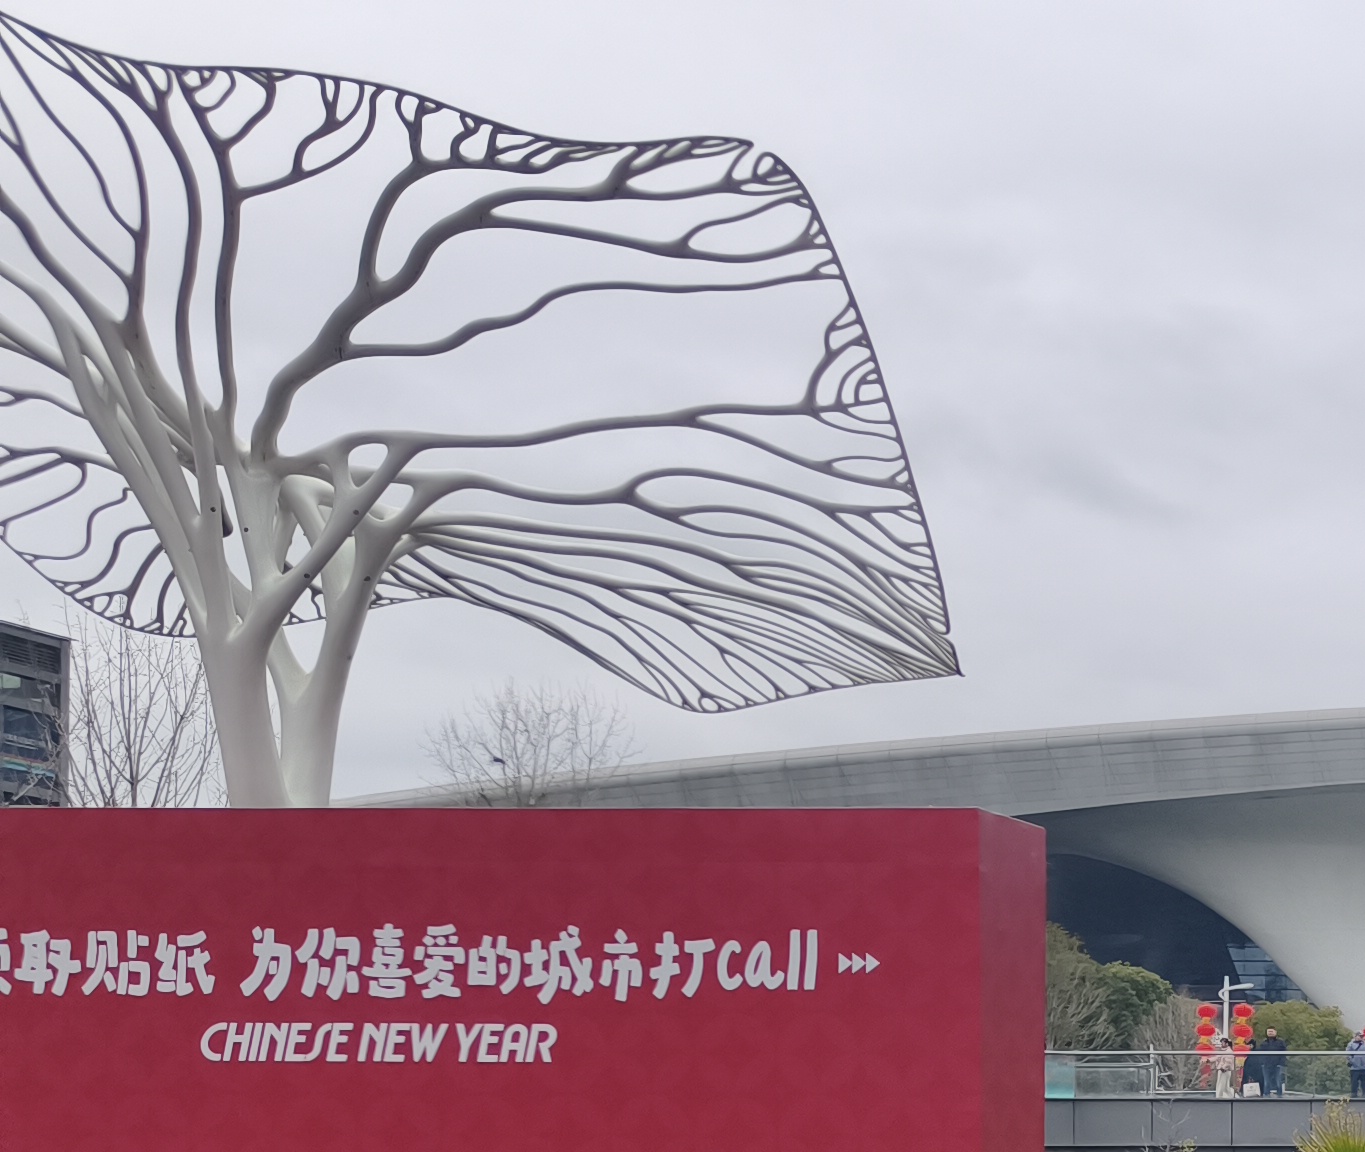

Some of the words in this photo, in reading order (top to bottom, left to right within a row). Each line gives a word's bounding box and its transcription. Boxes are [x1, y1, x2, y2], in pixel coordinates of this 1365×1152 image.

[201, 1022, 353, 1062] CHINESE
[357, 1022, 448, 1062] NEW
[456, 1022, 558, 1063] YEAR
